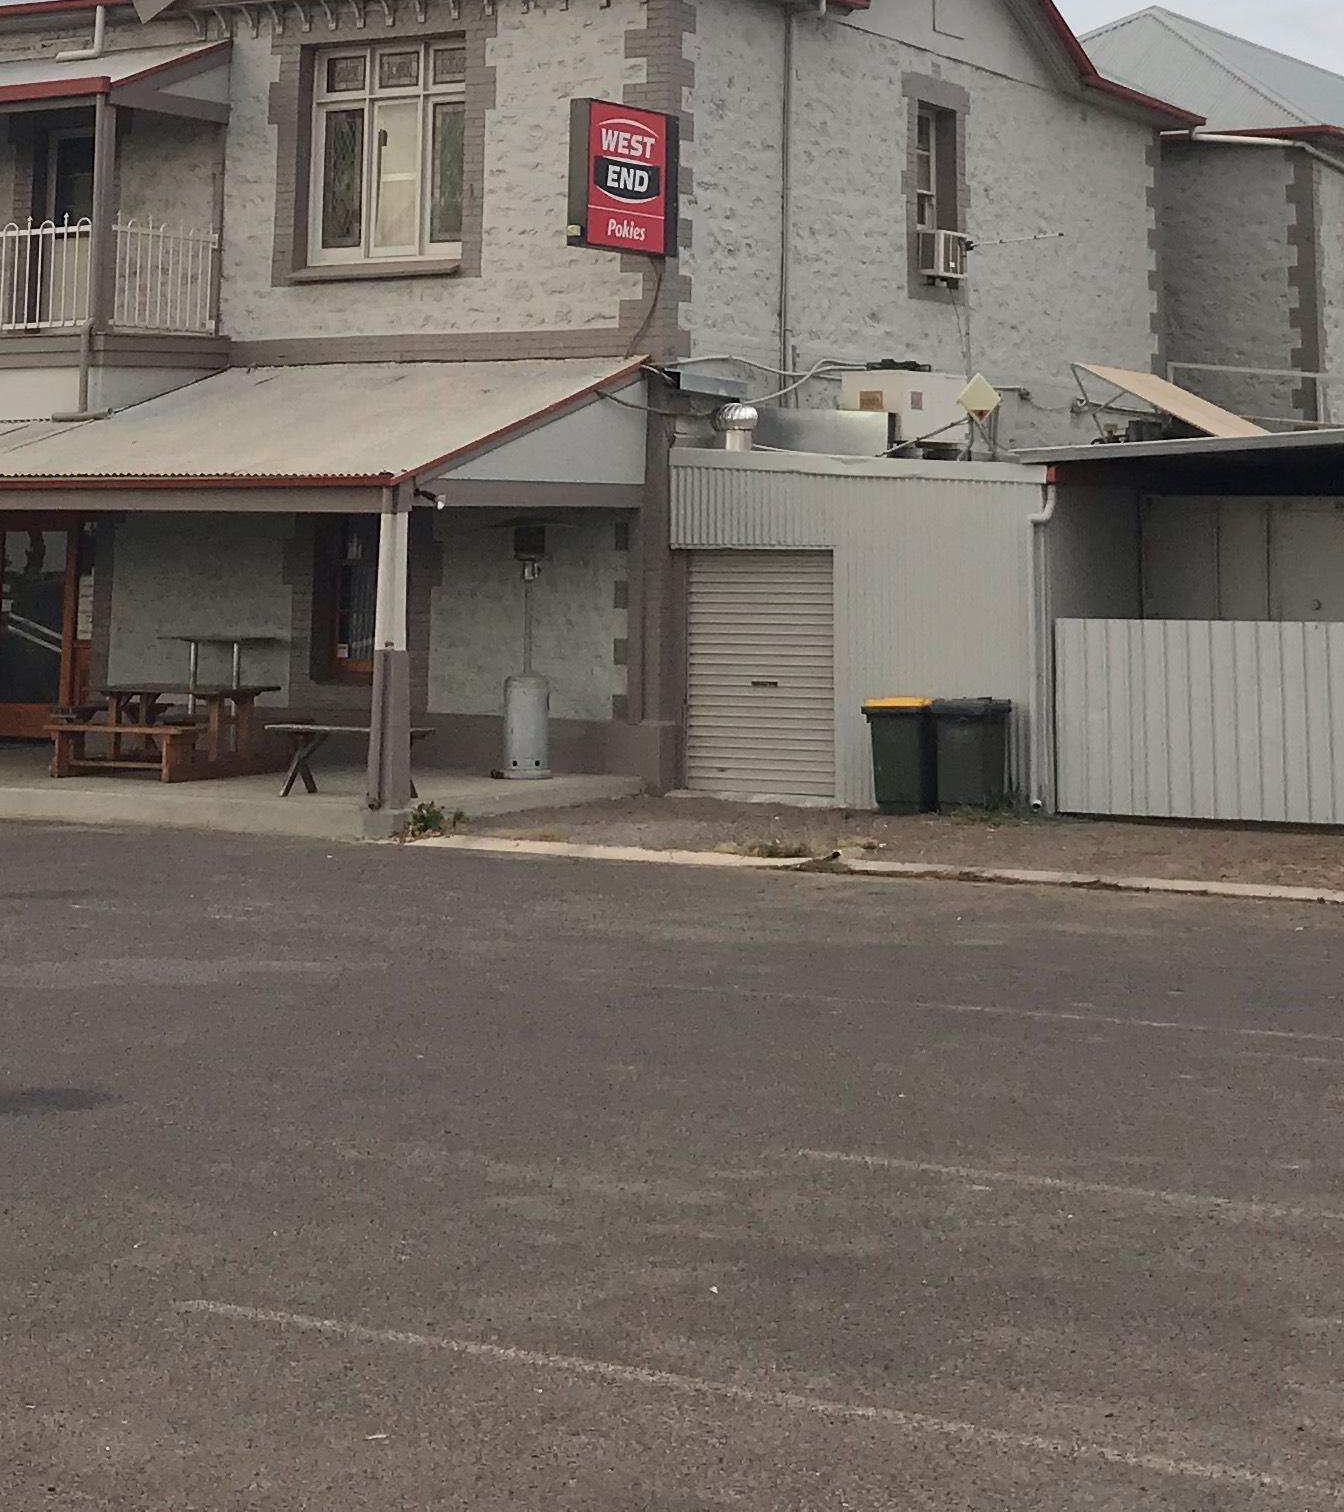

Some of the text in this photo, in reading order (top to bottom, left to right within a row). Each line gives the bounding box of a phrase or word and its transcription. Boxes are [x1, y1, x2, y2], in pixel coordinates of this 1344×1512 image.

[601, 128, 656, 159] WEST
[606, 165, 650, 193] END
[607, 218, 646, 241] Pokies
